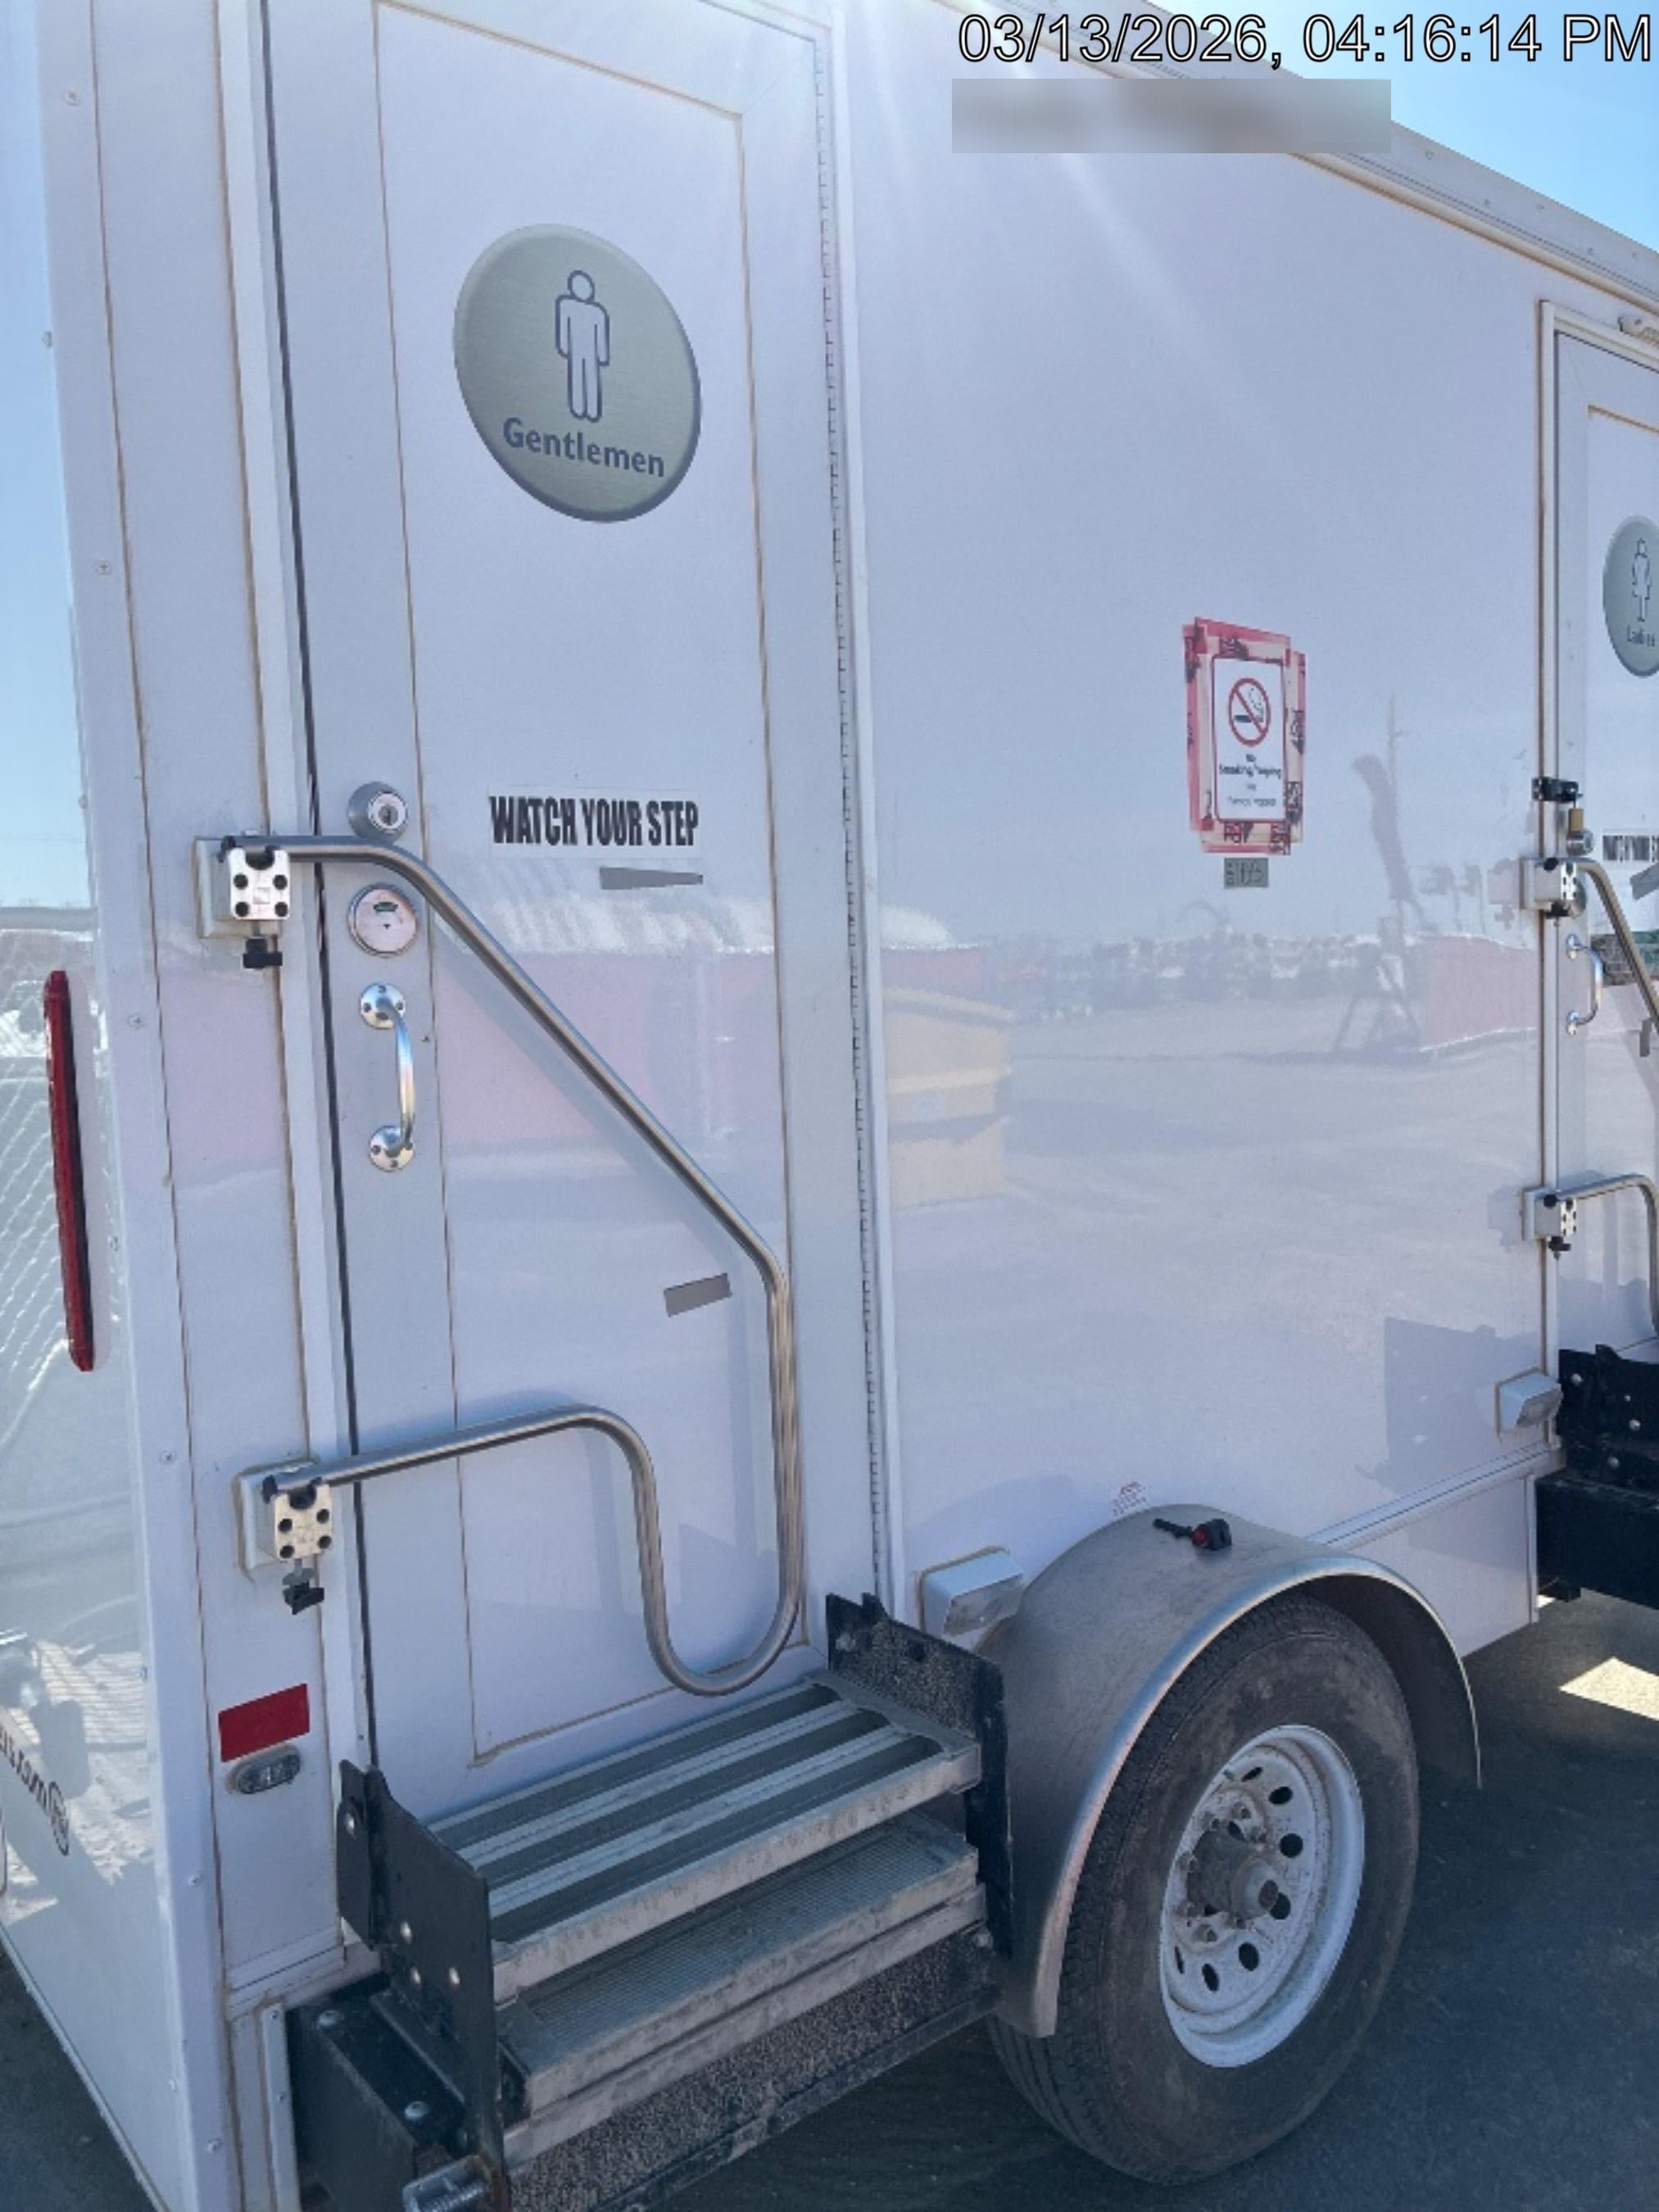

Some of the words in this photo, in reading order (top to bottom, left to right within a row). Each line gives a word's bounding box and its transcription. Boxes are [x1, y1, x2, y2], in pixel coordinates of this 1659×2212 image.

[501, 416, 665, 478] Gentlemen
[488, 795, 578, 846] WATCH
[580, 798, 643, 846] YOUR
[648, 800, 700, 847] STEP
